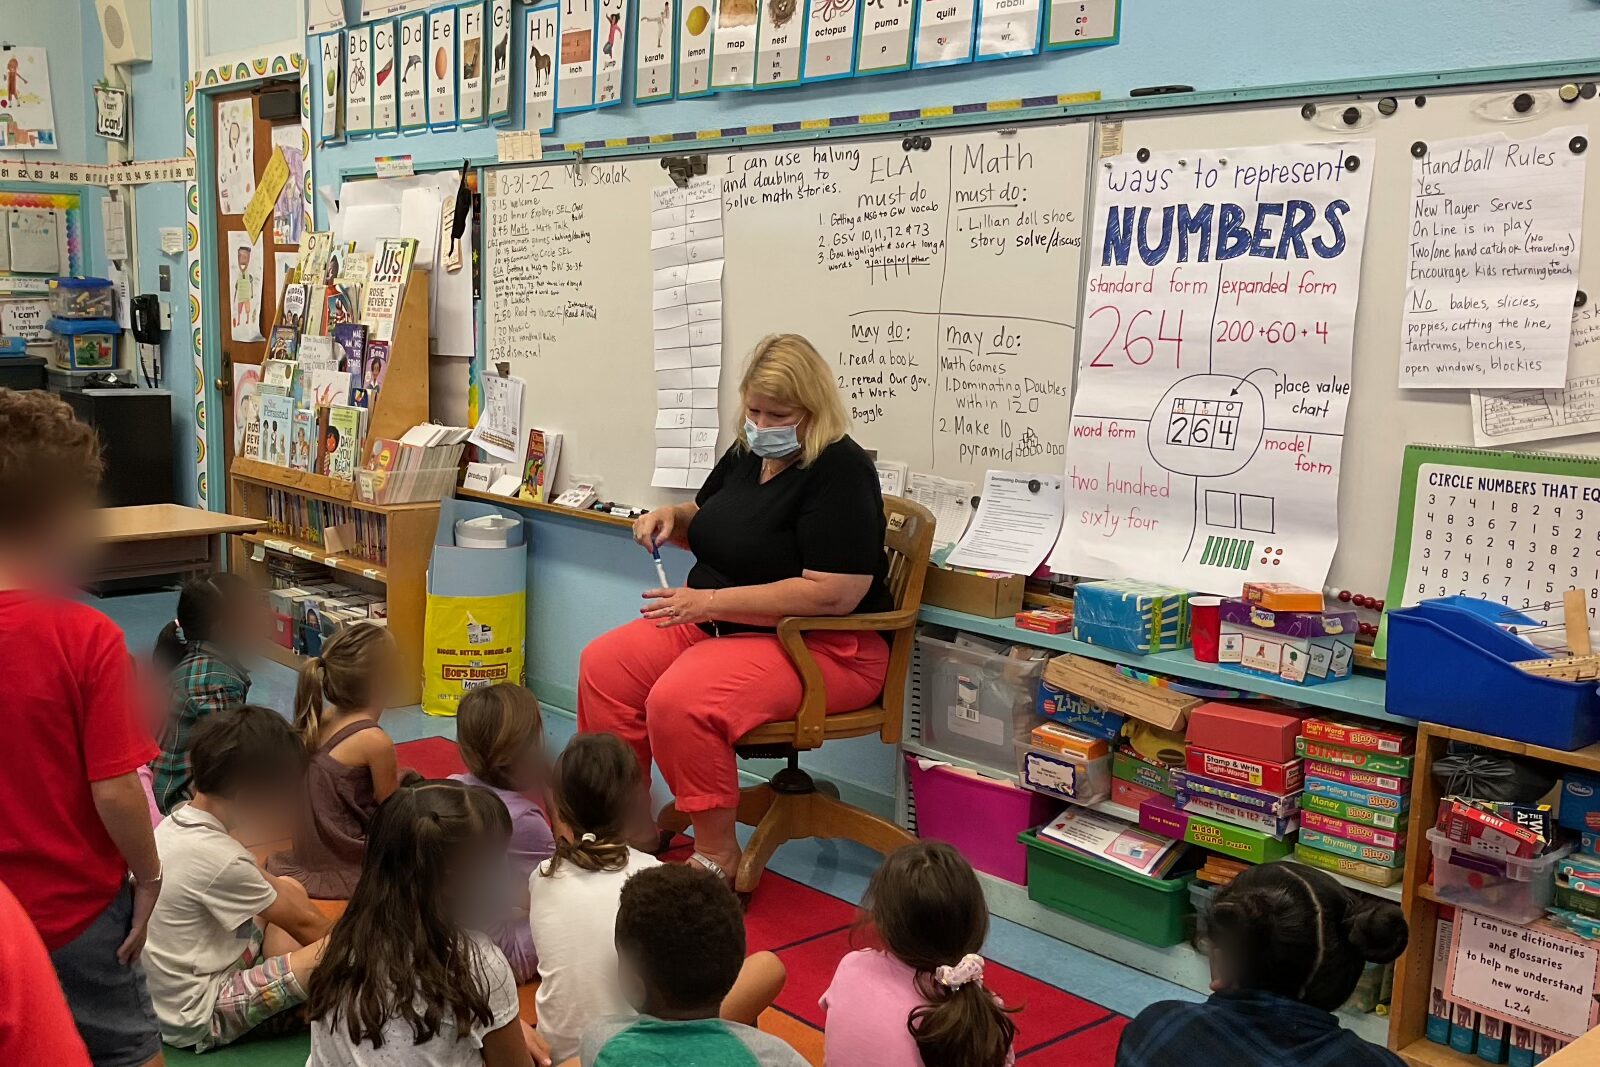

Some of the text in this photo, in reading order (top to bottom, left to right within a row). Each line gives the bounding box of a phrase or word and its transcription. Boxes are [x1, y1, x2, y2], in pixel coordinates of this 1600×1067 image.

[874, 17, 898, 29] puma
[936, 6, 956, 20] quilt
[772, 36, 787, 45] nest
[815, 24, 846, 37] octopus
[688, 48, 706, 58] lemon
[727, 40, 745, 50] map
[644, 52, 664, 63] karate
[569, 65, 582, 74] inch
[727, 147, 860, 174] I can use halving
[964, 143, 1032, 174] Math
[1421, 144, 1556, 175] Handball Rules
[34, 170, 78, 181] 83 84 85
[502, 171, 553, 195] 8-31-22
[590, 165, 631, 185] Skalak
[871, 155, 913, 184] ELA
[1108, 150, 1345, 201] ways to represent
[723, 173, 746, 193] and
[754, 171, 804, 189] doubling
[815, 168, 829, 180] to
[1417, 176, 1440, 195] Yes
[726, 184, 841, 212] solve math stories.
[858, 181, 927, 208] must do
[956, 182, 1027, 202] must do:
[969, 214, 1010, 230] Lillian
[1016, 210, 1038, 226] doll
[1043, 209, 1075, 224] shoe
[1415, 198, 1532, 220] New Player Serves
[1101, 200, 1351, 266] NUMBERS
[1412, 217, 1533, 237] On Line is in play
[971, 233, 1006, 255] story
[1454, 243, 1477, 263] hand
[1480, 242, 1506, 254] catch
[1090, 266, 1208, 295] standard form
[1410, 261, 1469, 283] Encourage
[1475, 262, 1497, 277] kids
[1221, 270, 1337, 306] expanded form
[1412, 289, 1432, 310] No
[1451, 319, 1492, 333] cutting
[1499, 319, 1519, 328] the
[1524, 318, 1551, 330] line,
[993, 325, 1022, 349] do:
[1089, 306, 1183, 368] 264
[1466, 336, 1526, 351] benchies,
[849, 349, 875, 366] read
[879, 356, 887, 366] a
[890, 350, 919, 367] book
[940, 356, 1006, 374] Math Games
[1405, 355, 1542, 376] open windows, blockies
[851, 372, 883, 385] reread
[953, 378, 1022, 398] Dominating
[1024, 377, 1067, 396] Doubles
[1274, 373, 1350, 400] place value
[851, 389, 864, 399] at
[852, 403, 884, 424] Boggle
[1292, 398, 1329, 418] chart
[954, 416, 989, 435] Make
[1000, 418, 1011, 438] 10
[1073, 421, 1136, 439] word form
[959, 442, 1013, 464] pyramid
[1265, 435, 1312, 453] model
[1294, 454, 1332, 475] form
[1070, 462, 1170, 498] two hundred
[1429, 472, 1474, 490] CIRCLE
[1478, 477, 1536, 496] NUMBERS
[1542, 483, 1578, 500] THAT
[1350, 733, 1378, 747] Bingo
[1206, 756, 1230, 766] Stamp
[1240, 763, 1260, 773] Write
[1207, 764, 1248, 778] Sight-Words
[1309, 762, 1345, 777] Addition
[1311, 796, 1339, 810] Money
[1192, 825, 1221, 836] Middle
[1194, 834, 1223, 845] Sound
[1322, 835, 1357, 851] Rhyming
[1362, 847, 1391, 862] Bingo
[1473, 918, 1585, 959] I can use dictionaries
[1488, 940, 1563, 970] and glossaries
[1466, 950, 1584, 996] to help me understand
[1492, 978, 1549, 1003] new words.
[1505, 999, 1531, 1015] L.2.4
